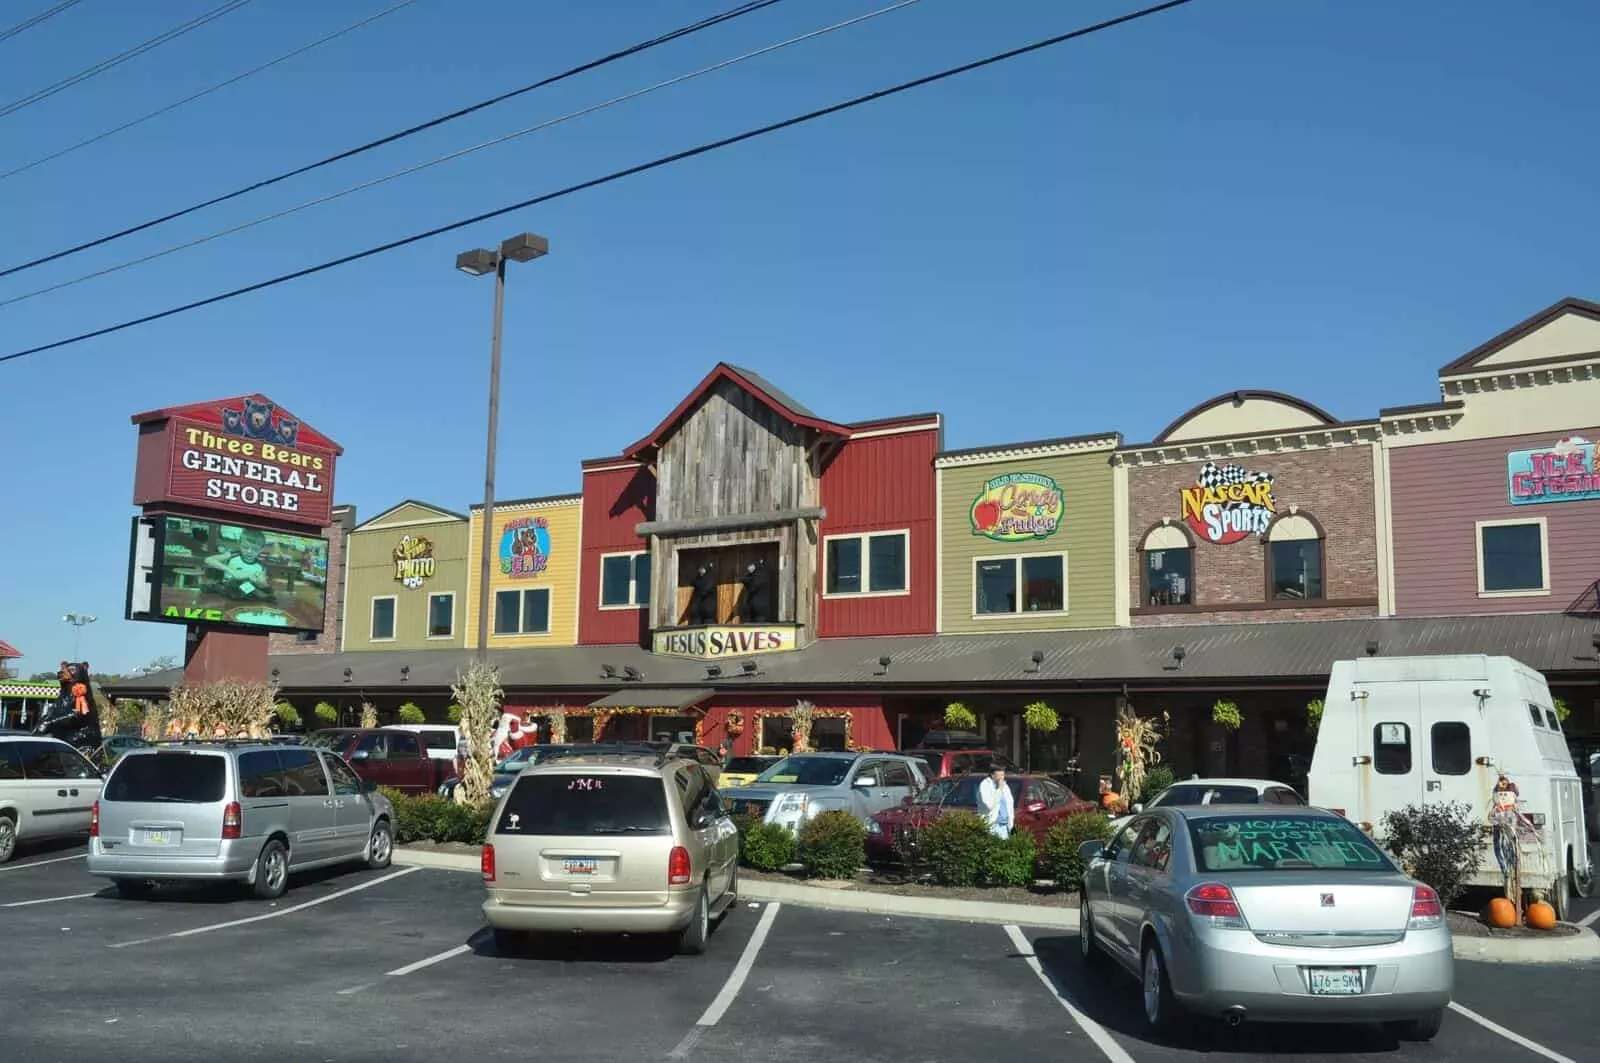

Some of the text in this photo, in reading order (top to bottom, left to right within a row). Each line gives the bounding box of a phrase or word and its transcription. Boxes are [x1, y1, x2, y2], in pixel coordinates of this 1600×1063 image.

[185, 427, 323, 470] Three Bears
[1531, 449, 1586, 479] ICE
[182, 449, 322, 492] GENERAL
[206, 478, 298, 511] STORE
[1180, 481, 1276, 522] NASCAR
[664, 631, 782, 655] JESUS SAVES
[1238, 831, 1322, 842] JUST
[1216, 841, 1381, 866] MARRIED
